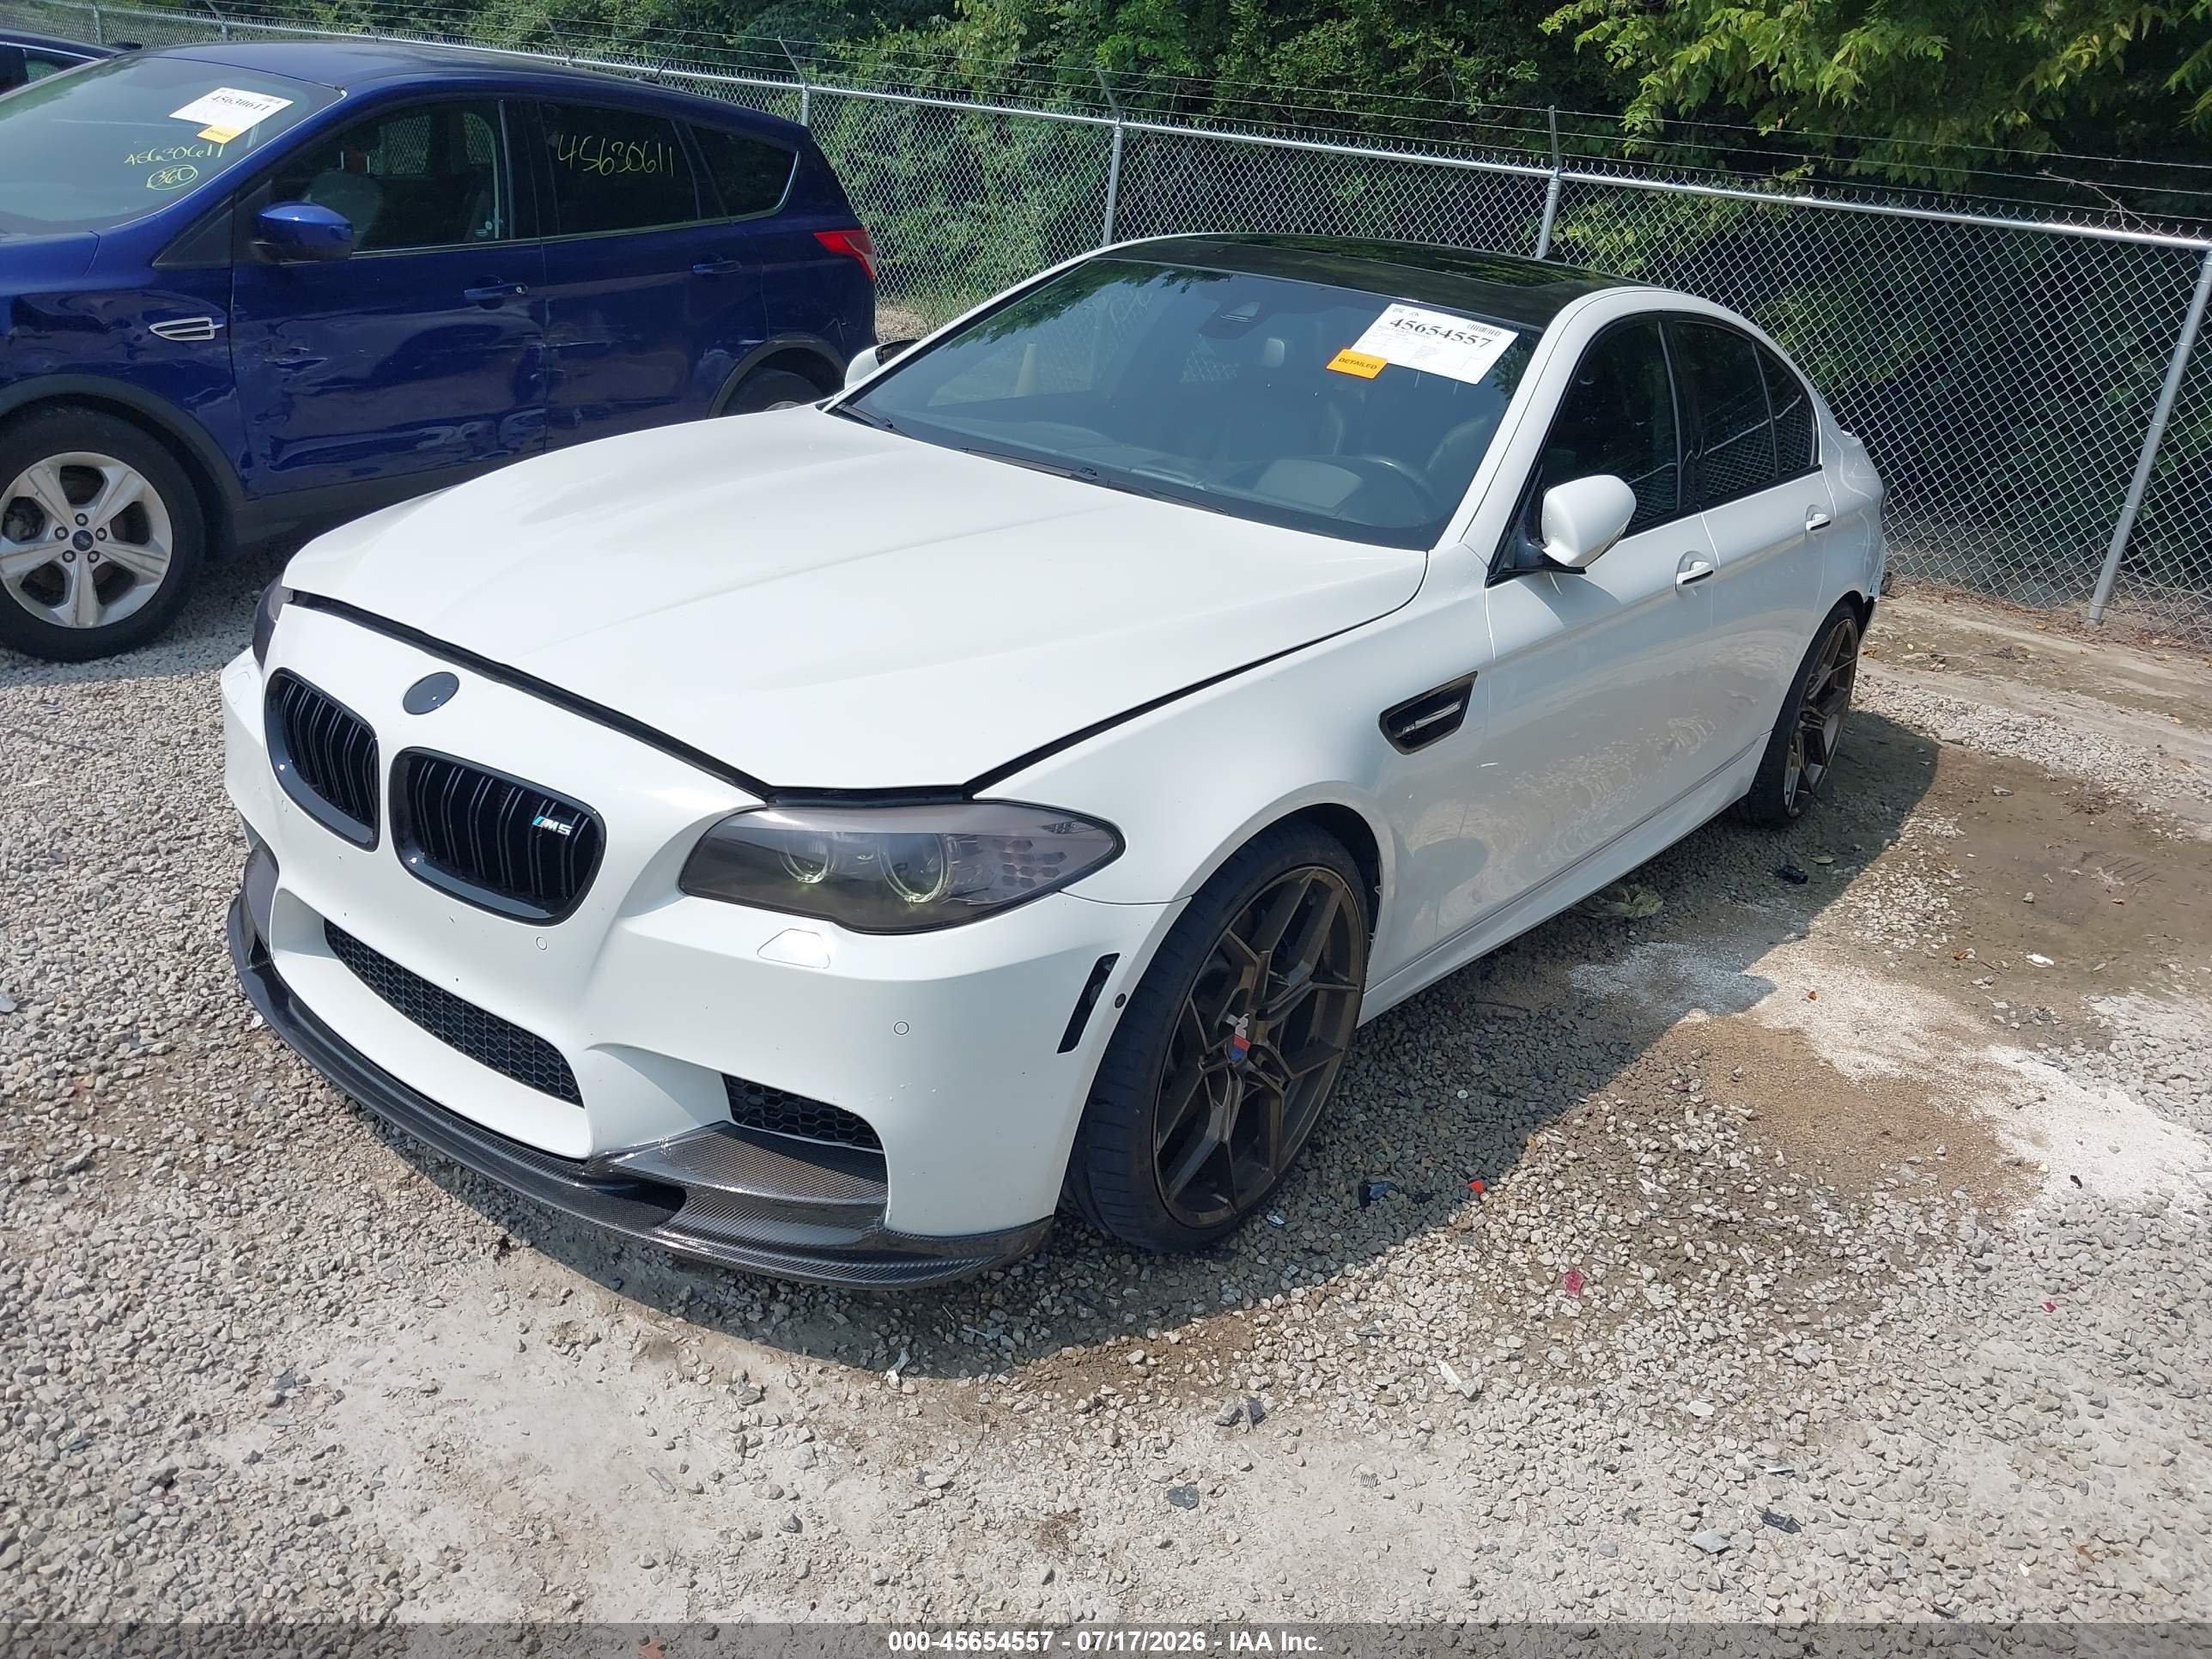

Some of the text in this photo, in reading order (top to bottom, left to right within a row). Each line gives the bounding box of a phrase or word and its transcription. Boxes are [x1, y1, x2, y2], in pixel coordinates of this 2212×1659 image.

[212, 95, 271, 112] 45630611
[556, 133, 674, 178] 45630611
[1389, 317, 1493, 349] 45654557
[1338, 357, 1377, 370] DETAILED
[541, 817, 573, 836] M5
